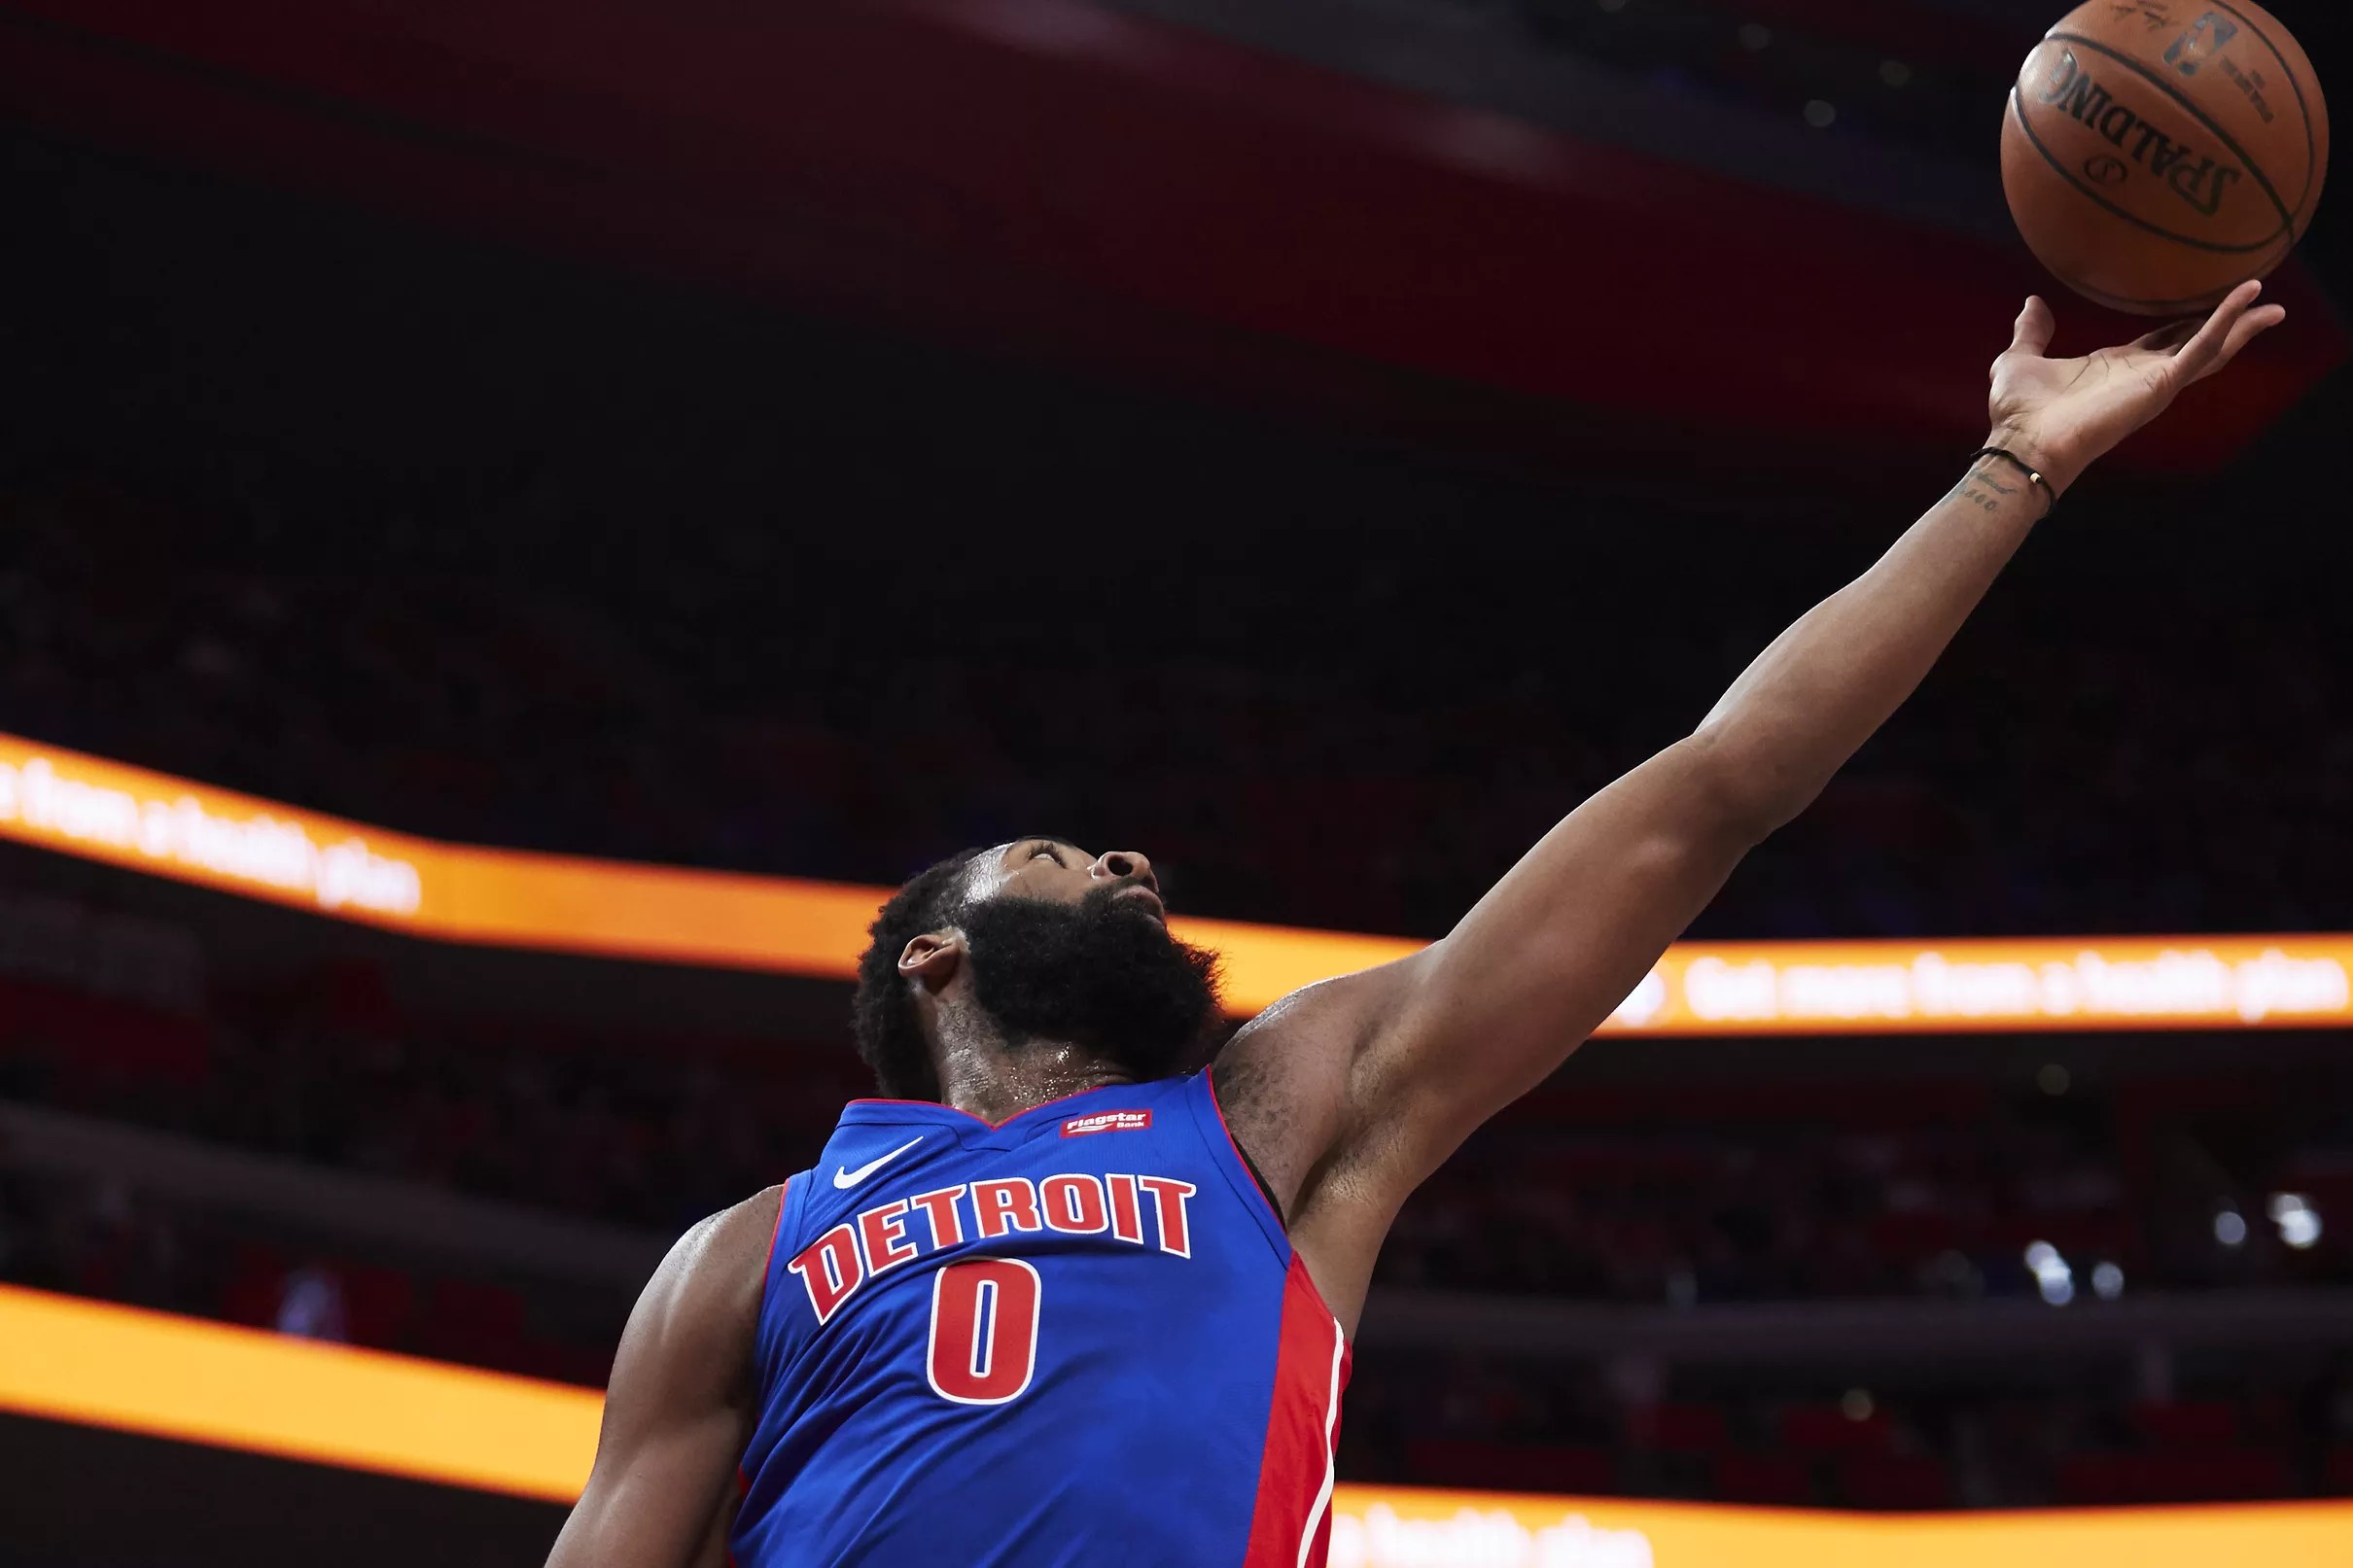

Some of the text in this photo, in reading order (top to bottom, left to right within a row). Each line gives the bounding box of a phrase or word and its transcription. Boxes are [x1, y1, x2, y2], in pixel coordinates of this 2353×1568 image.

[2039, 49, 2241, 217] SPALDING
[1067, 1112, 1146, 1130] Flagstar
[788, 1173, 1196, 1326] DETROIT
[927, 1258, 1042, 1406] 0
